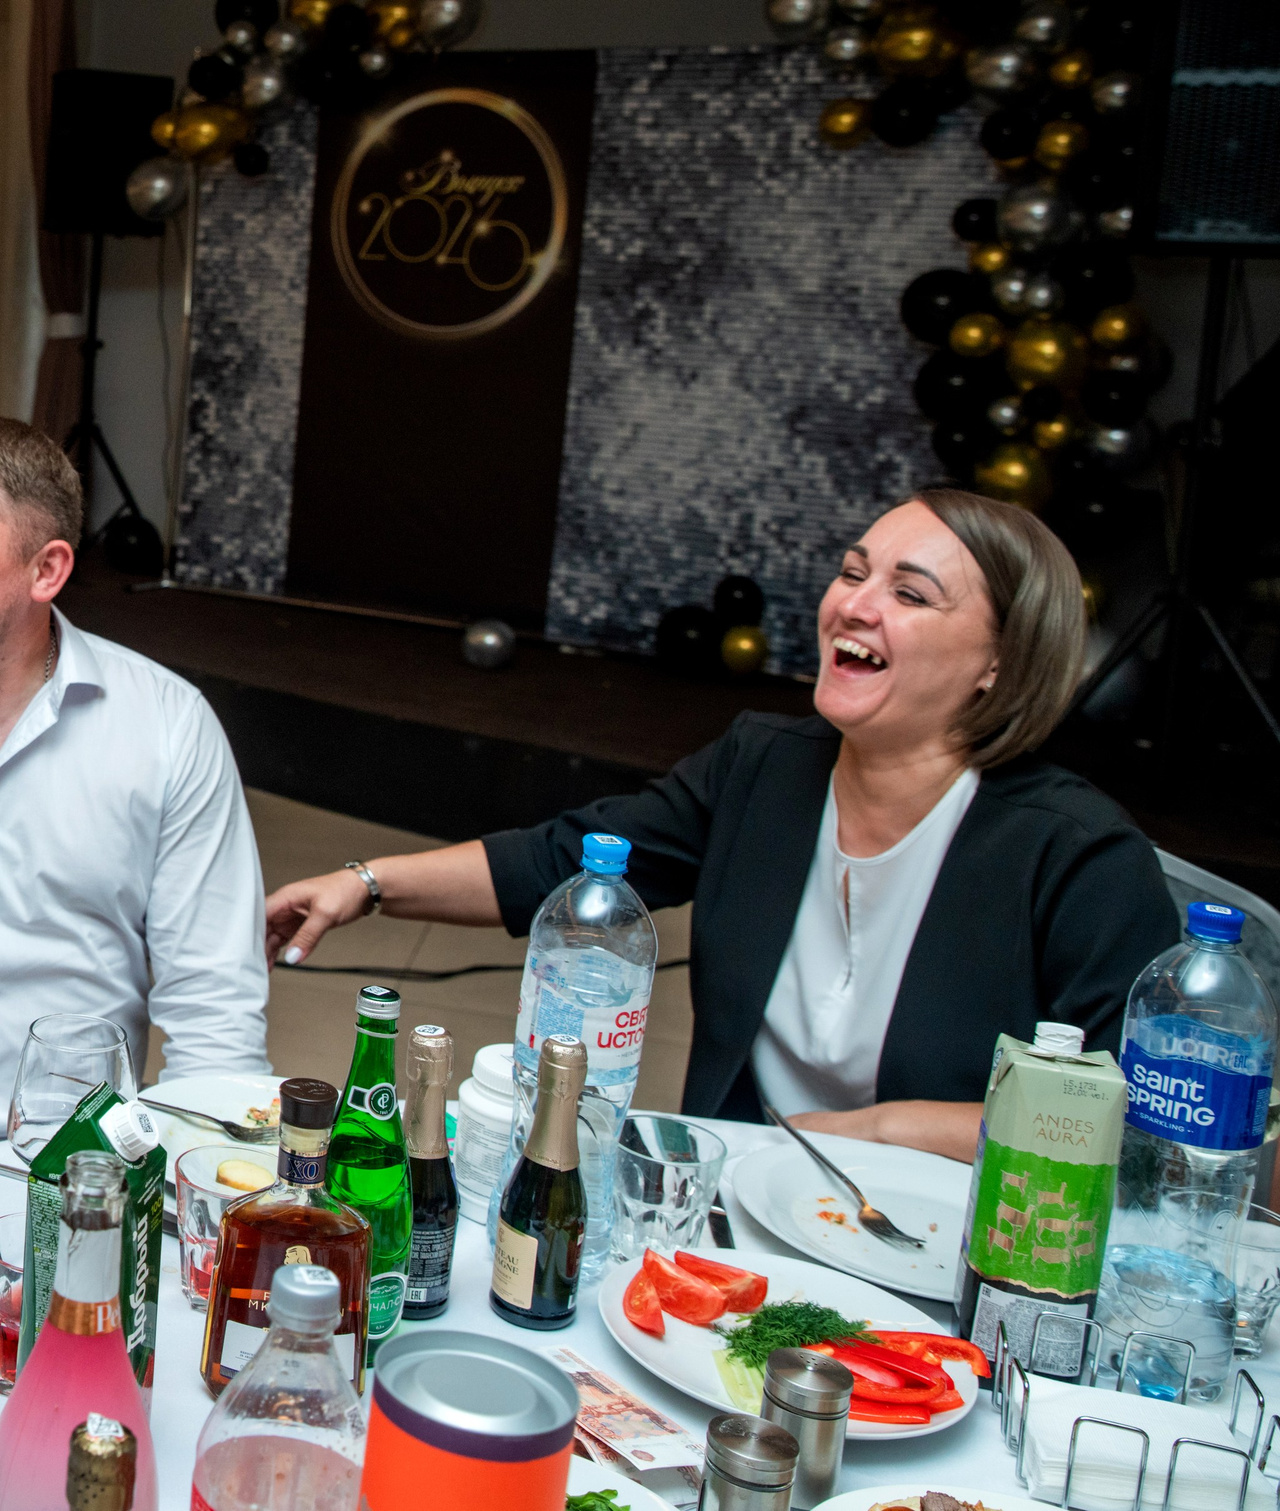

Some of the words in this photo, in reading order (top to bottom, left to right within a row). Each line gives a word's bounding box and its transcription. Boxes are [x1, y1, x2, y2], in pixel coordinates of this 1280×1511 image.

[1032, 1112, 1095, 1134] ANDES
[1139, 1112, 1185, 1133] SPARKLING
[1035, 1127, 1088, 1148] AURA
[286, 1157, 320, 1180] XO
[127, 1213, 149, 1353] Добрый
